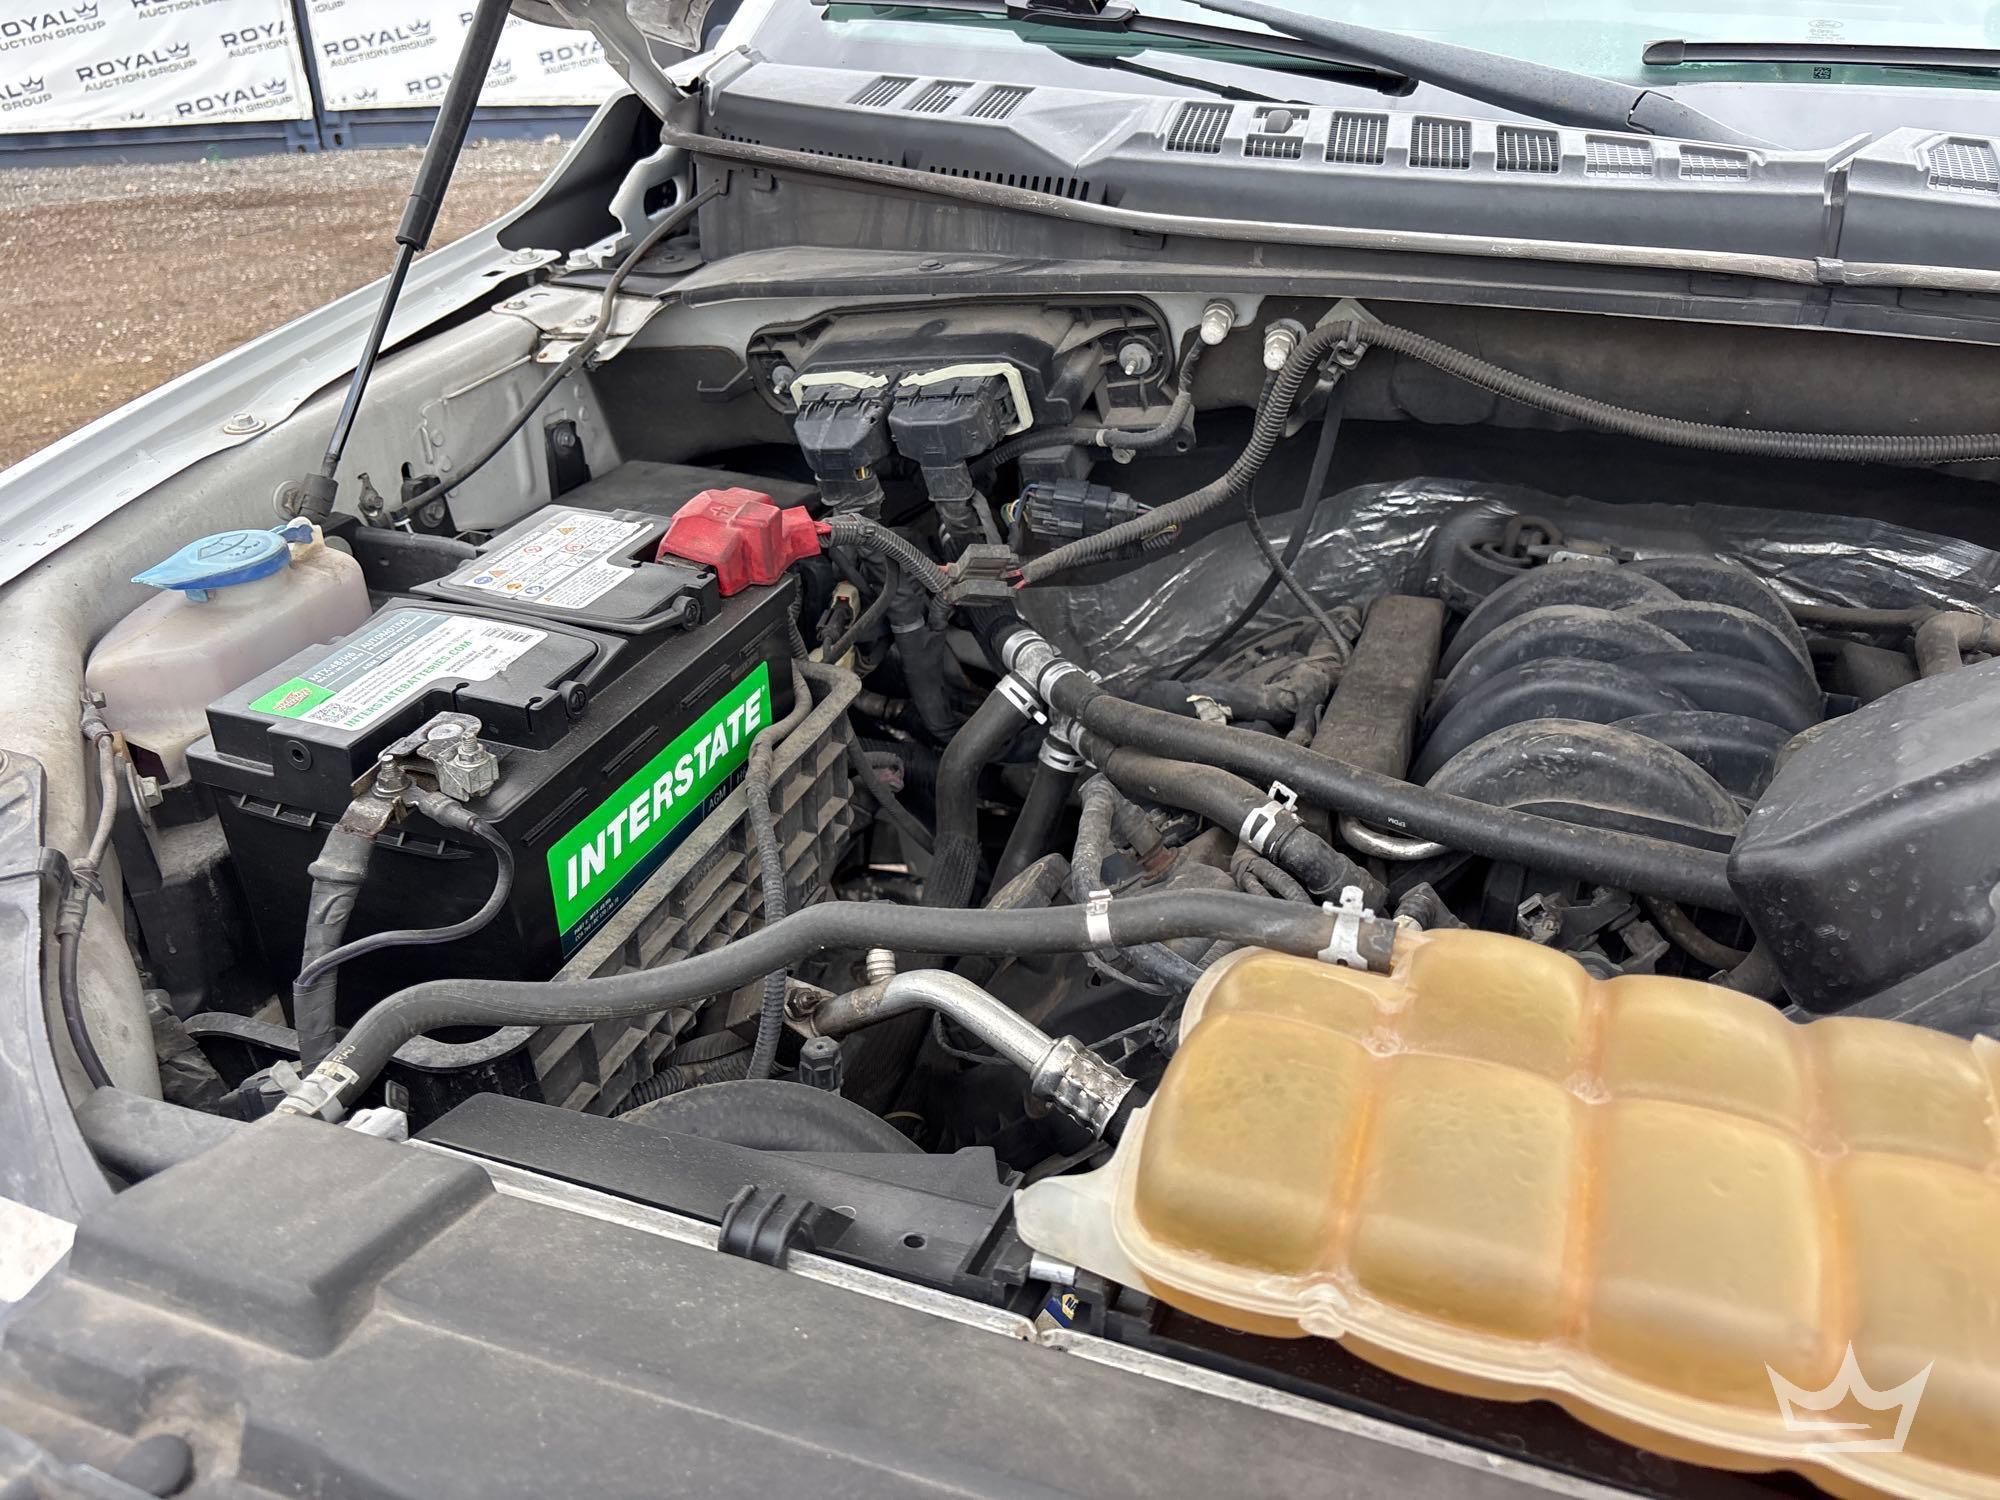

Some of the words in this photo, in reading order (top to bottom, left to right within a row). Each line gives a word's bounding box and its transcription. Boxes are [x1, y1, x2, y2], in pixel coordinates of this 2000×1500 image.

[0, 10, 76, 39] OYAL
[0, 32, 54, 52] UCTION
[55, 20, 107, 40] GROUP
[323, 27, 410, 57] ROYAL
[537, 41, 604, 66] ROYA
[76, 47, 168, 83] ROYAL
[84, 71, 147, 93] AUCTION
[148, 58, 198, 79] GROUP
[1, 92, 53, 112] GROUP
[176, 85, 265, 118] ROYAL
[360, 617, 411, 649] AUTOMOTIVE
[344, 640, 472, 727] INTERSTATEBATTERIES.COM
[567, 689, 761, 902] INTERSTATE
[708, 785, 727, 811] AGM
